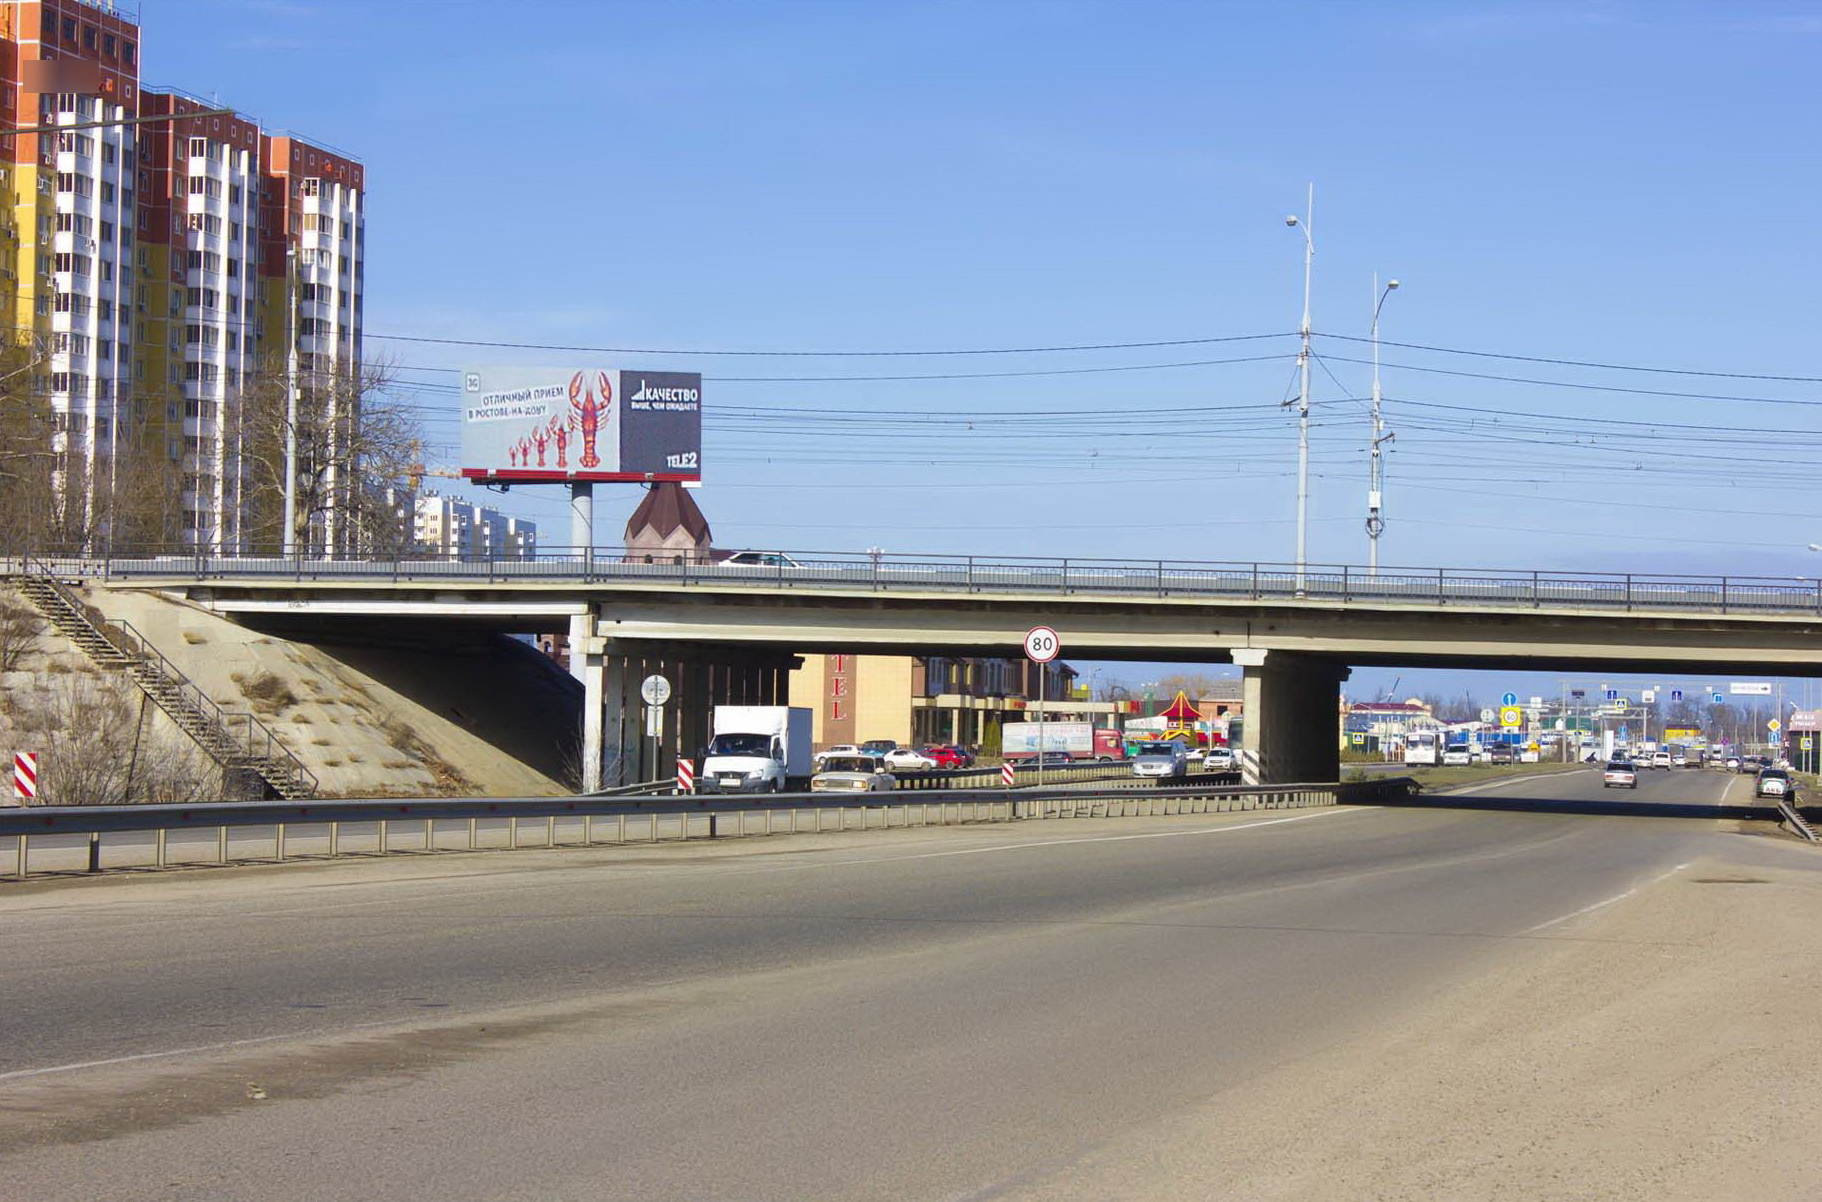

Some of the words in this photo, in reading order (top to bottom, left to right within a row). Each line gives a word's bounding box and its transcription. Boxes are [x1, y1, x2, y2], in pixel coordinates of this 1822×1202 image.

[483, 389, 531, 405] ОТЛИЧНЫЙ
[647, 388, 698, 401] КАЧЕСТВО
[653, 402, 665, 410] ЧЕМ
[468, 410, 473, 419] В
[667, 452, 697, 468] TELE2
[1033, 637, 1052, 651] 80
